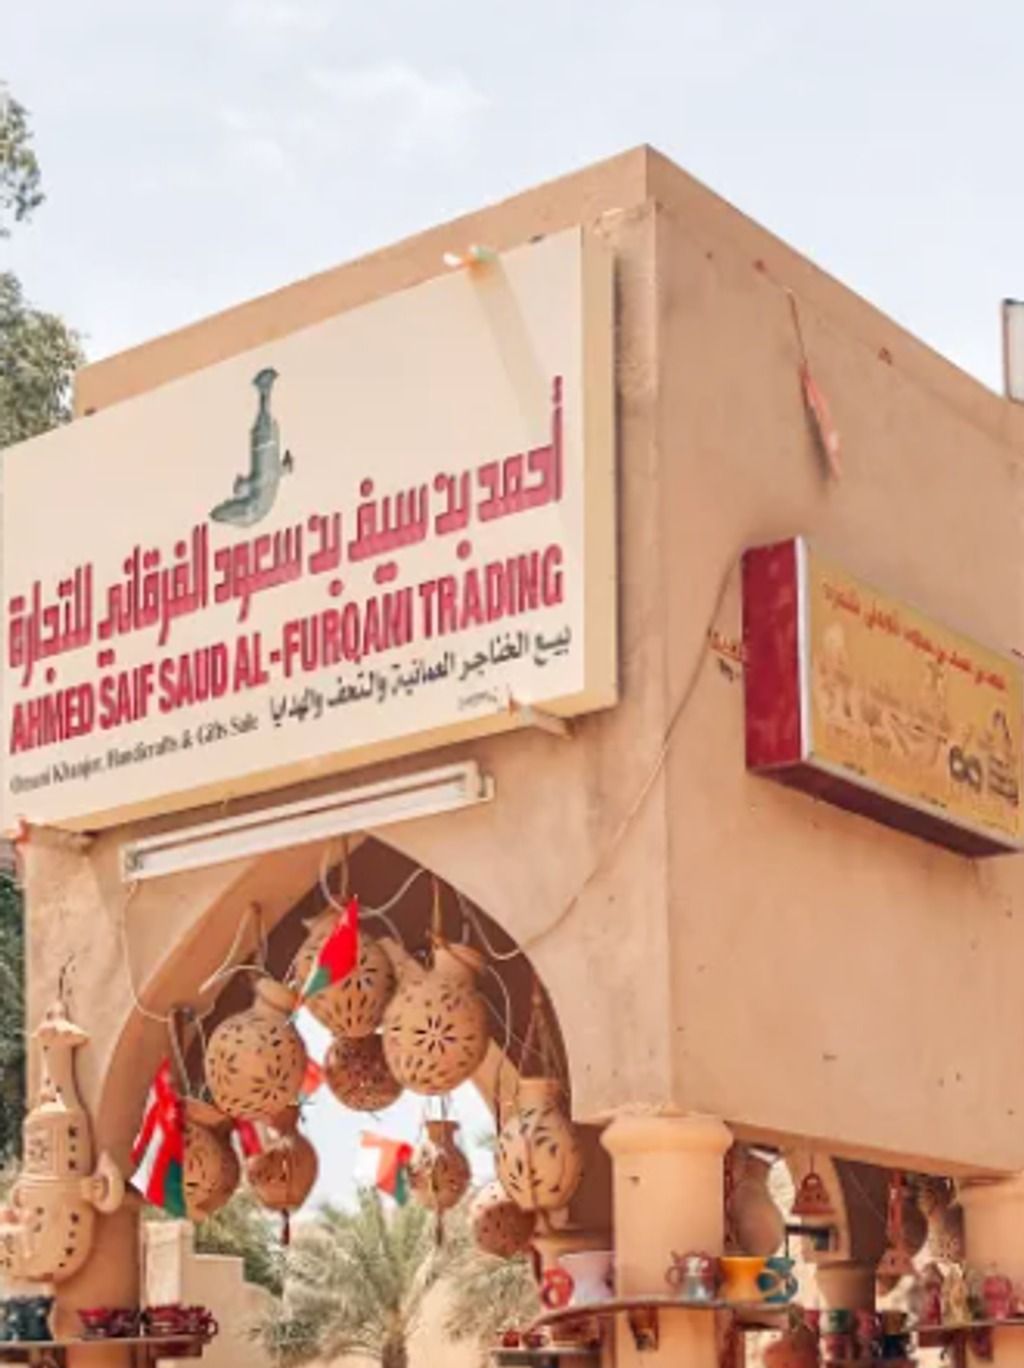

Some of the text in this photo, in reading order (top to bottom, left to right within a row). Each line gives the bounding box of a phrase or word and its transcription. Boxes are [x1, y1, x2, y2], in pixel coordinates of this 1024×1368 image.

[477, 375, 563, 523] أحمد
[213, 522, 303, 623] سعود
[347, 478, 429, 586] سيف
[9, 682, 95, 755] AHMED
[99, 662, 154, 731] SAIF
[158, 641, 229, 714] SAUD
[418, 543, 563, 640] TRADING
[181, 729, 194, 750] &
